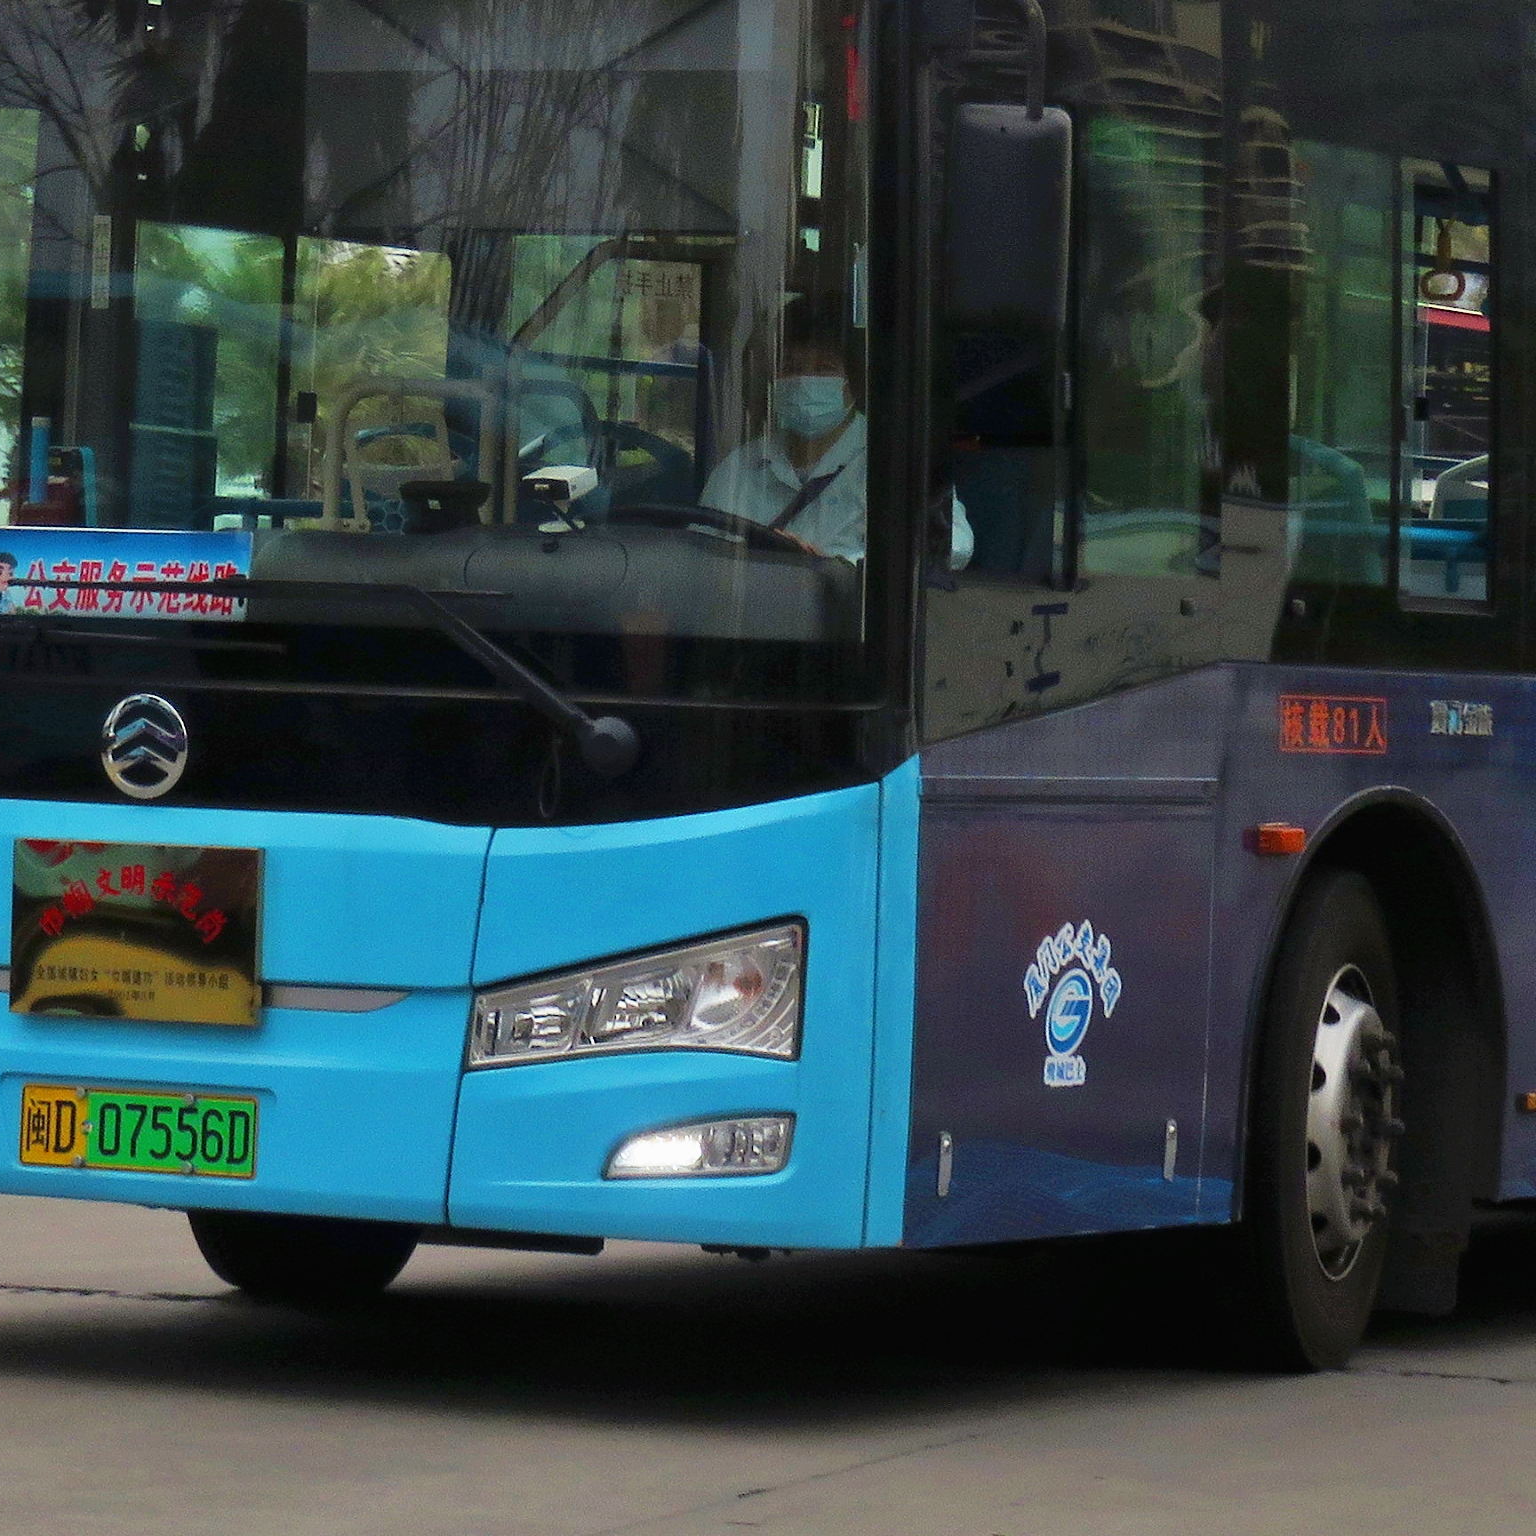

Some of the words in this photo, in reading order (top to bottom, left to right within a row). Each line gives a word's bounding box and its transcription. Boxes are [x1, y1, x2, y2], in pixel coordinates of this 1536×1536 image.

[22, 558, 239, 615] 公交服务示范线路
